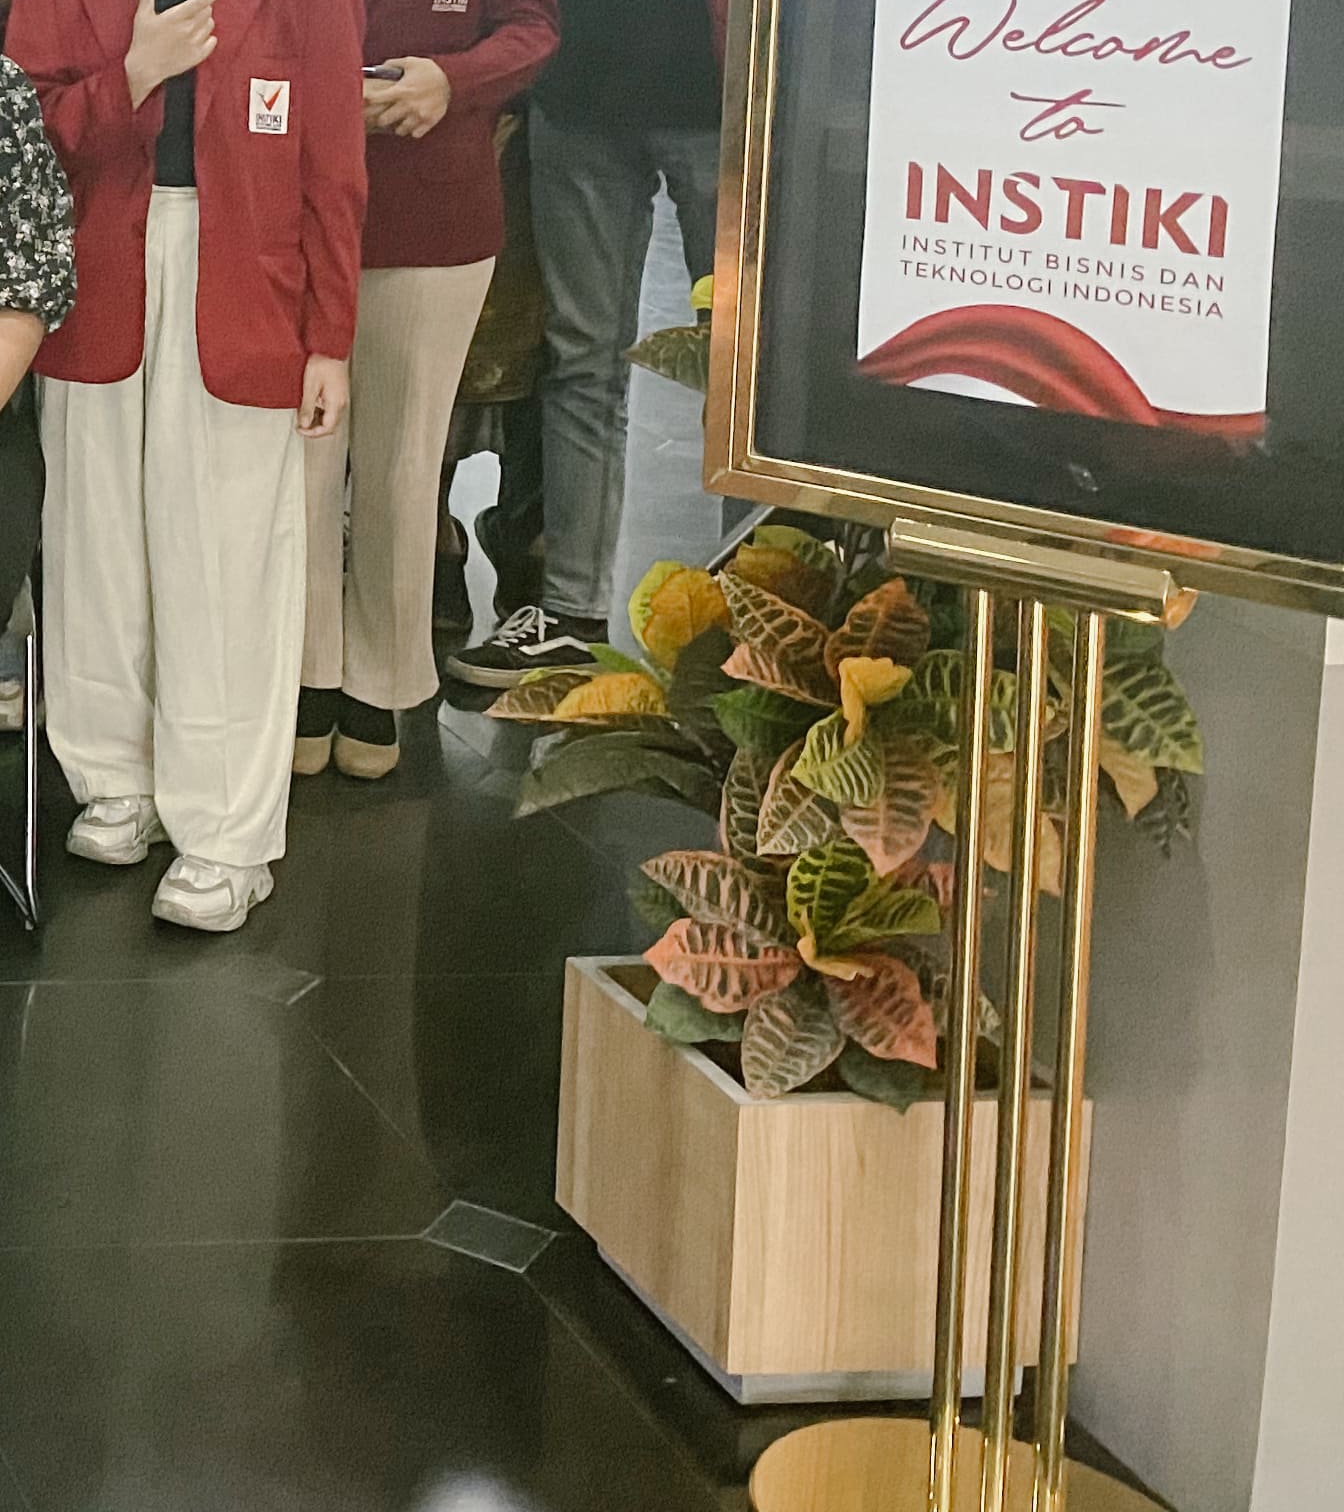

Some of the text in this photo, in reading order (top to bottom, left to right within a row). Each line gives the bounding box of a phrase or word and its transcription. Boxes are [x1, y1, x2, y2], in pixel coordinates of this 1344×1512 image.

[1009, 88, 1127, 142] to
[905, 160, 1230, 258] INSTIKI
[899, 259, 1224, 320] TEKNOLOGI INDONESIA
[901, 234, 1225, 293] INSTITUT BISNIS DAN
